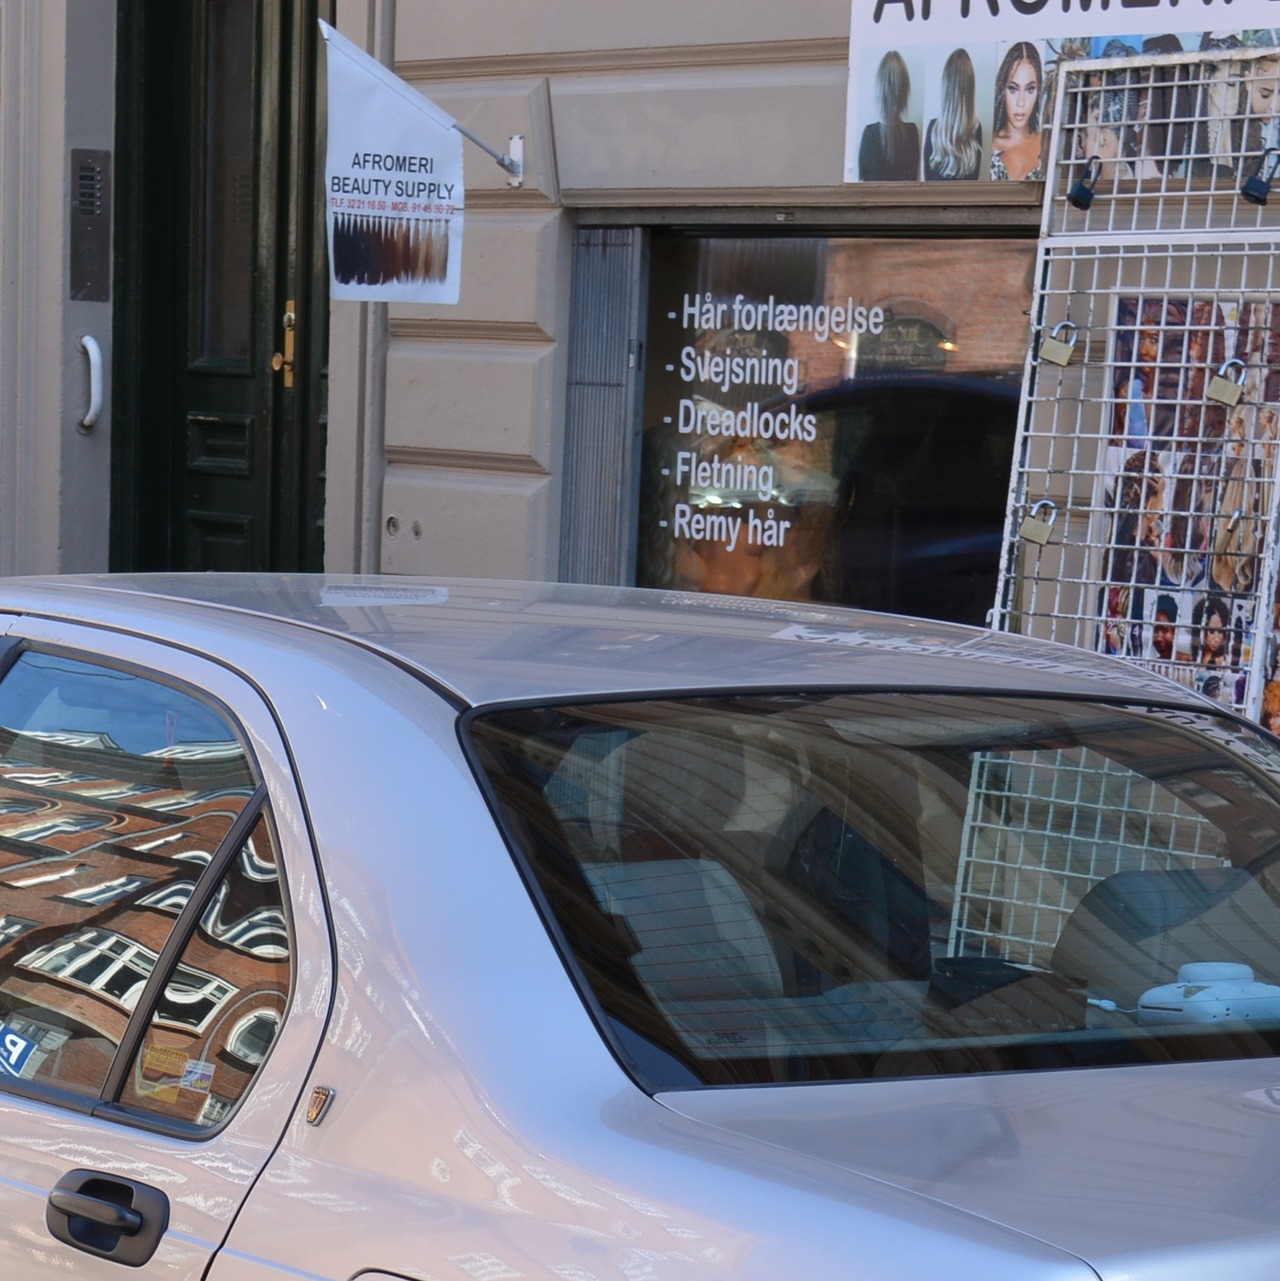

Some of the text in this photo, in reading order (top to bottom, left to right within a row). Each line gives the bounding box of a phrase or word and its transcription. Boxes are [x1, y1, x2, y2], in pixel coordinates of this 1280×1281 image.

[350, 152, 434, 174] AFROMERI
[331, 176, 455, 200] BEAUTY SUPPLY
[331, 197, 346, 208] TLF.
[682, 292, 727, 330] Hår
[733, 294, 885, 342] forlængelse
[680, 346, 800, 395] Svejsning
[678, 399, 817, 442] Dreadlocks
[676, 451, 774, 501] Fletning
[674, 503, 742, 552] Remy
[747, 508, 792, 547] hår
